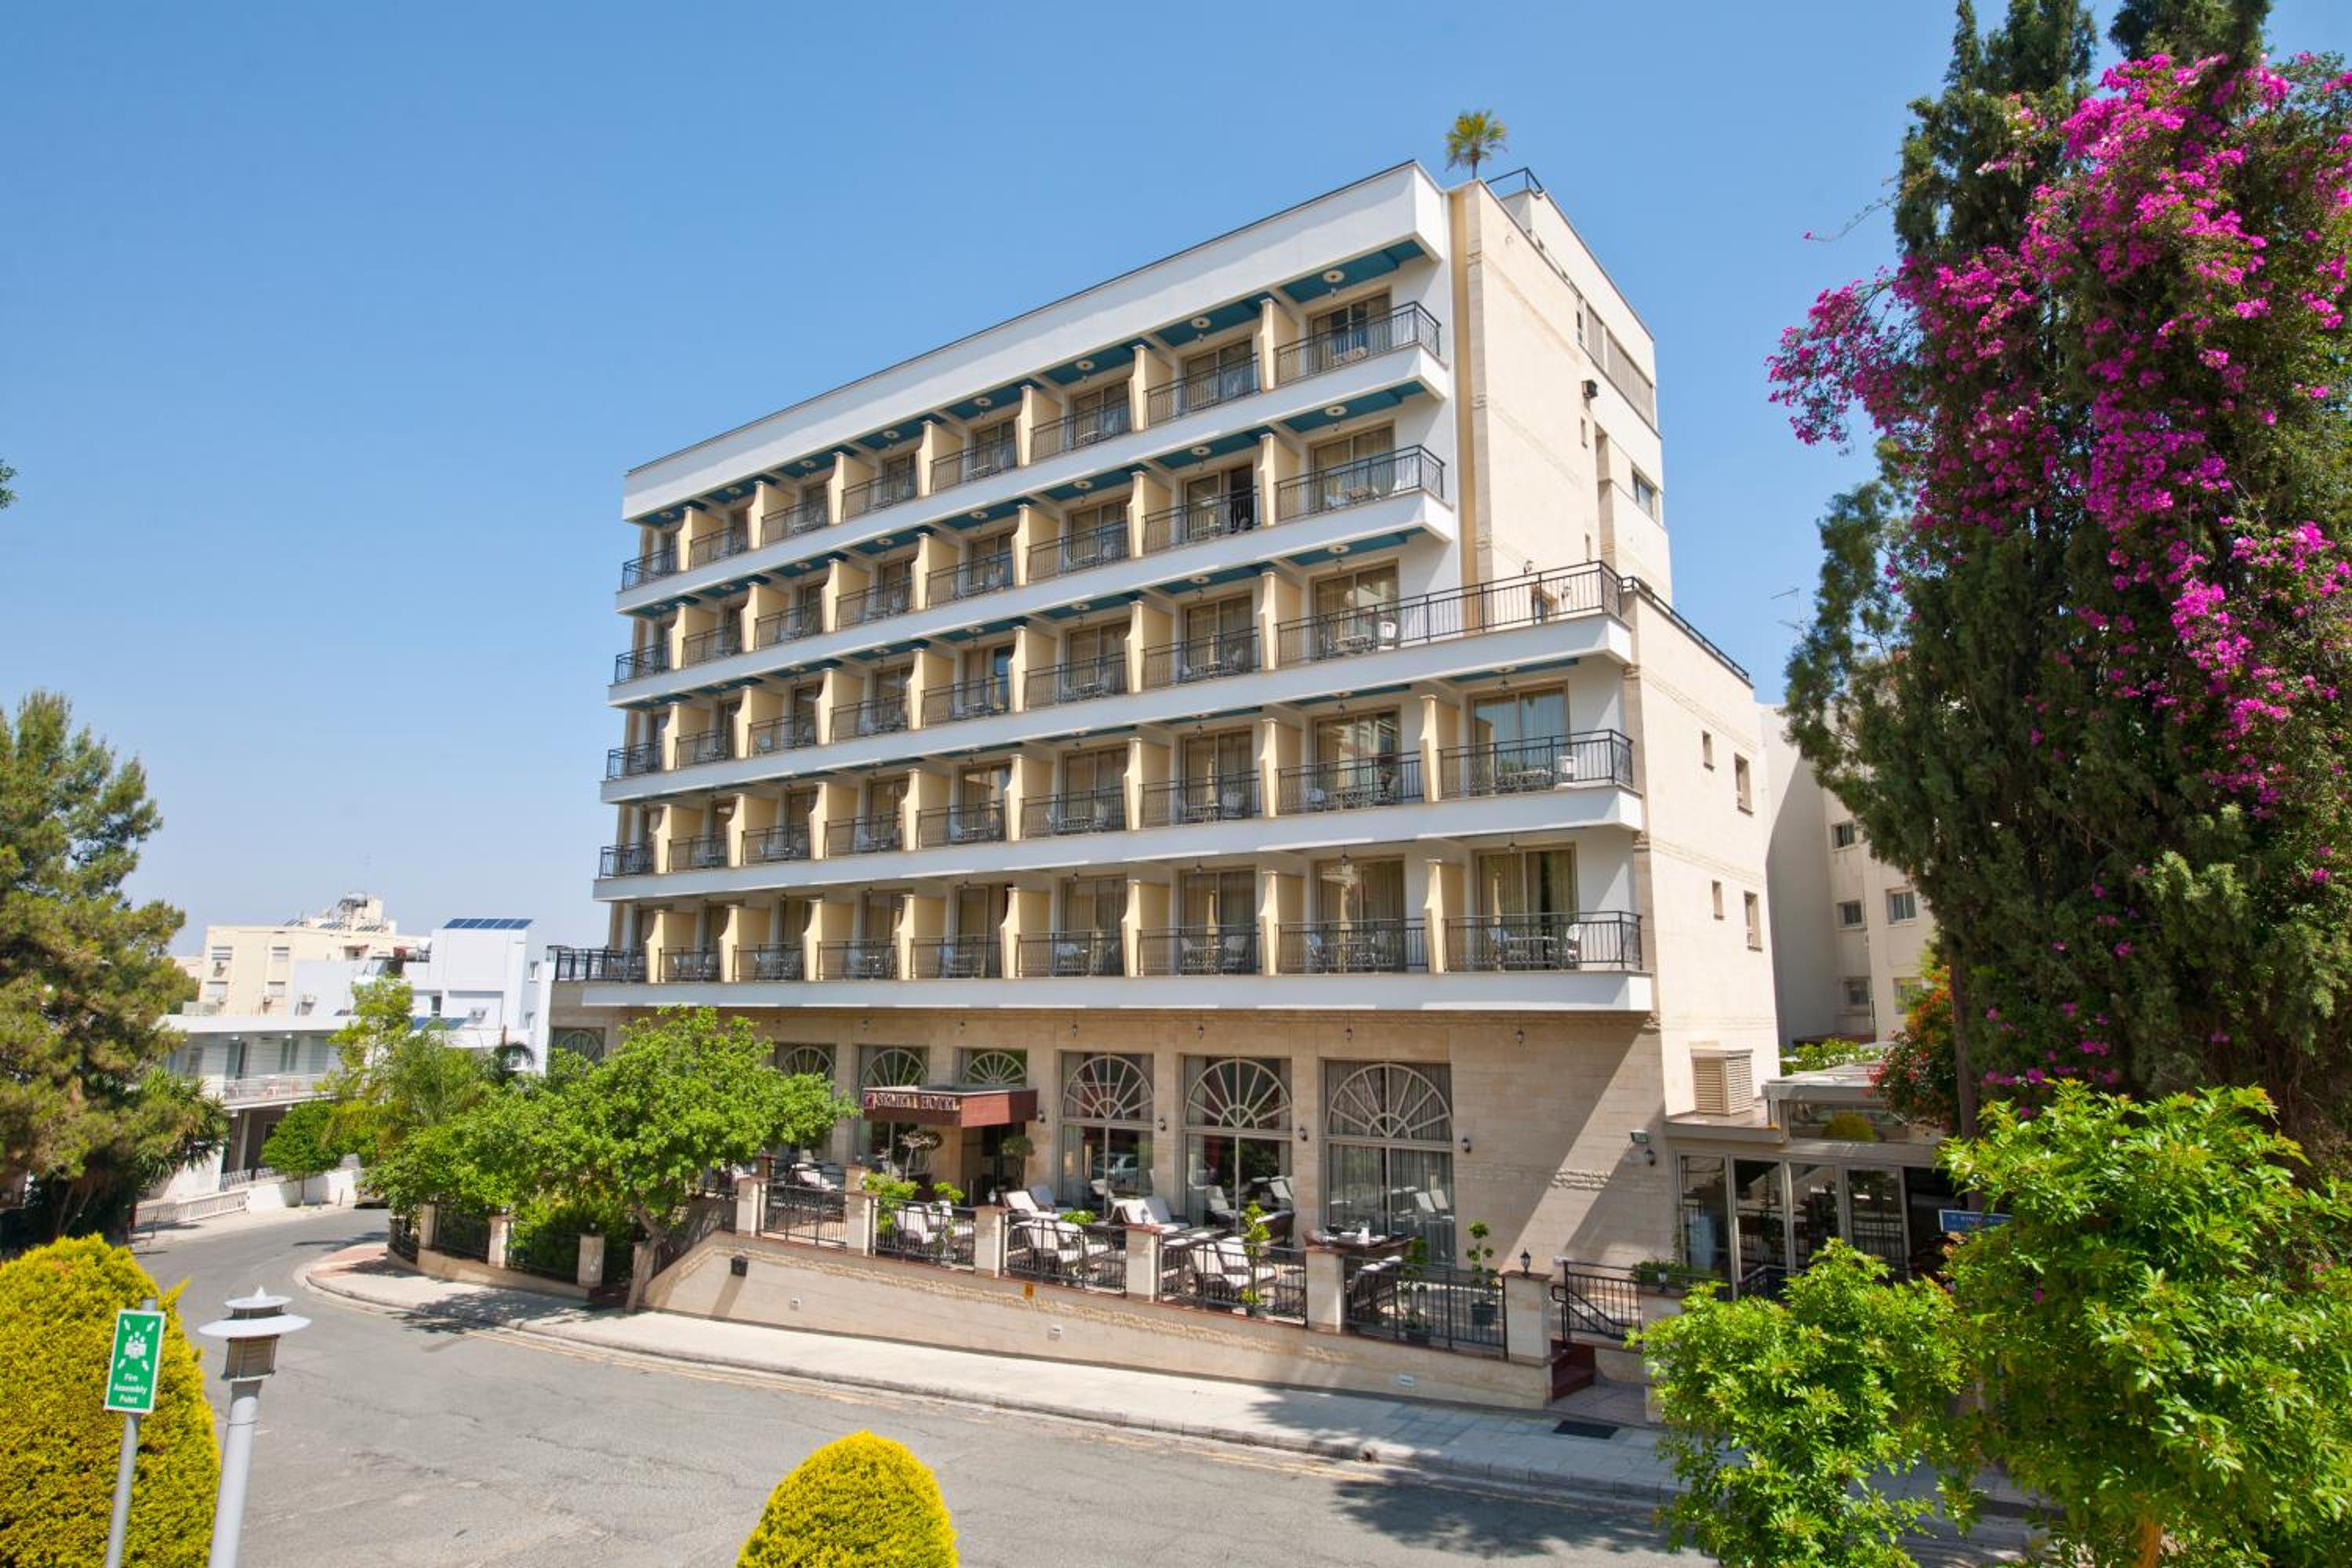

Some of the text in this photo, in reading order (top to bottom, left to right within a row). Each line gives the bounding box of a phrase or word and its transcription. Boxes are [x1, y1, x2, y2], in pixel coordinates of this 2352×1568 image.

[124, 1373, 139, 1382] Fire
[113, 1382, 148, 1395] Assembly
[118, 1394, 138, 1405] Point
